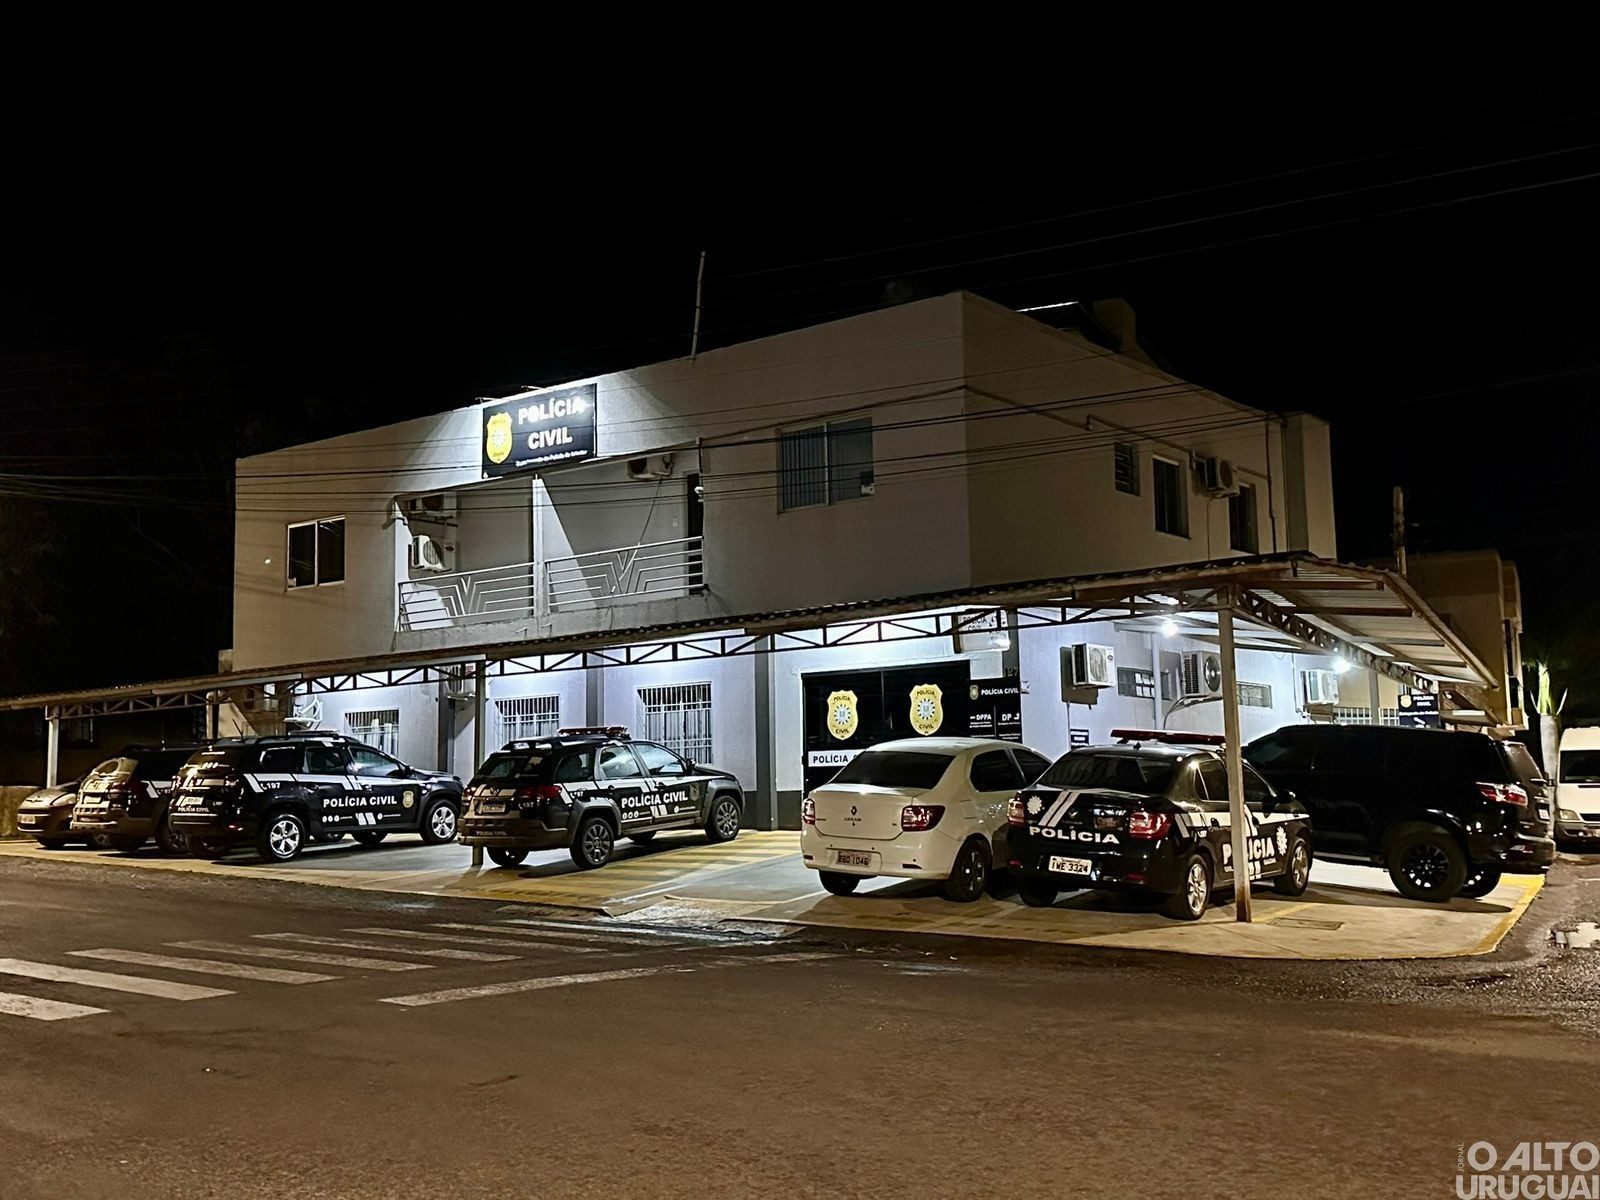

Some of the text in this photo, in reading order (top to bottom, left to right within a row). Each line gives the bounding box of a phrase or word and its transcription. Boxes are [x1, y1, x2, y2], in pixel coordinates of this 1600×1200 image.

[518, 396, 585, 424] POLÍCIA
[528, 427, 573, 449] CIVIL
[1002, 713, 1012, 721] DP
[813, 753, 848, 764] POLÍCIA
[323, 796, 397, 808] POLÍCIA CIVIL
[621, 790, 688, 808] POLÍCIA CIVIL
[1029, 825, 1120, 844] POLÍCIA
